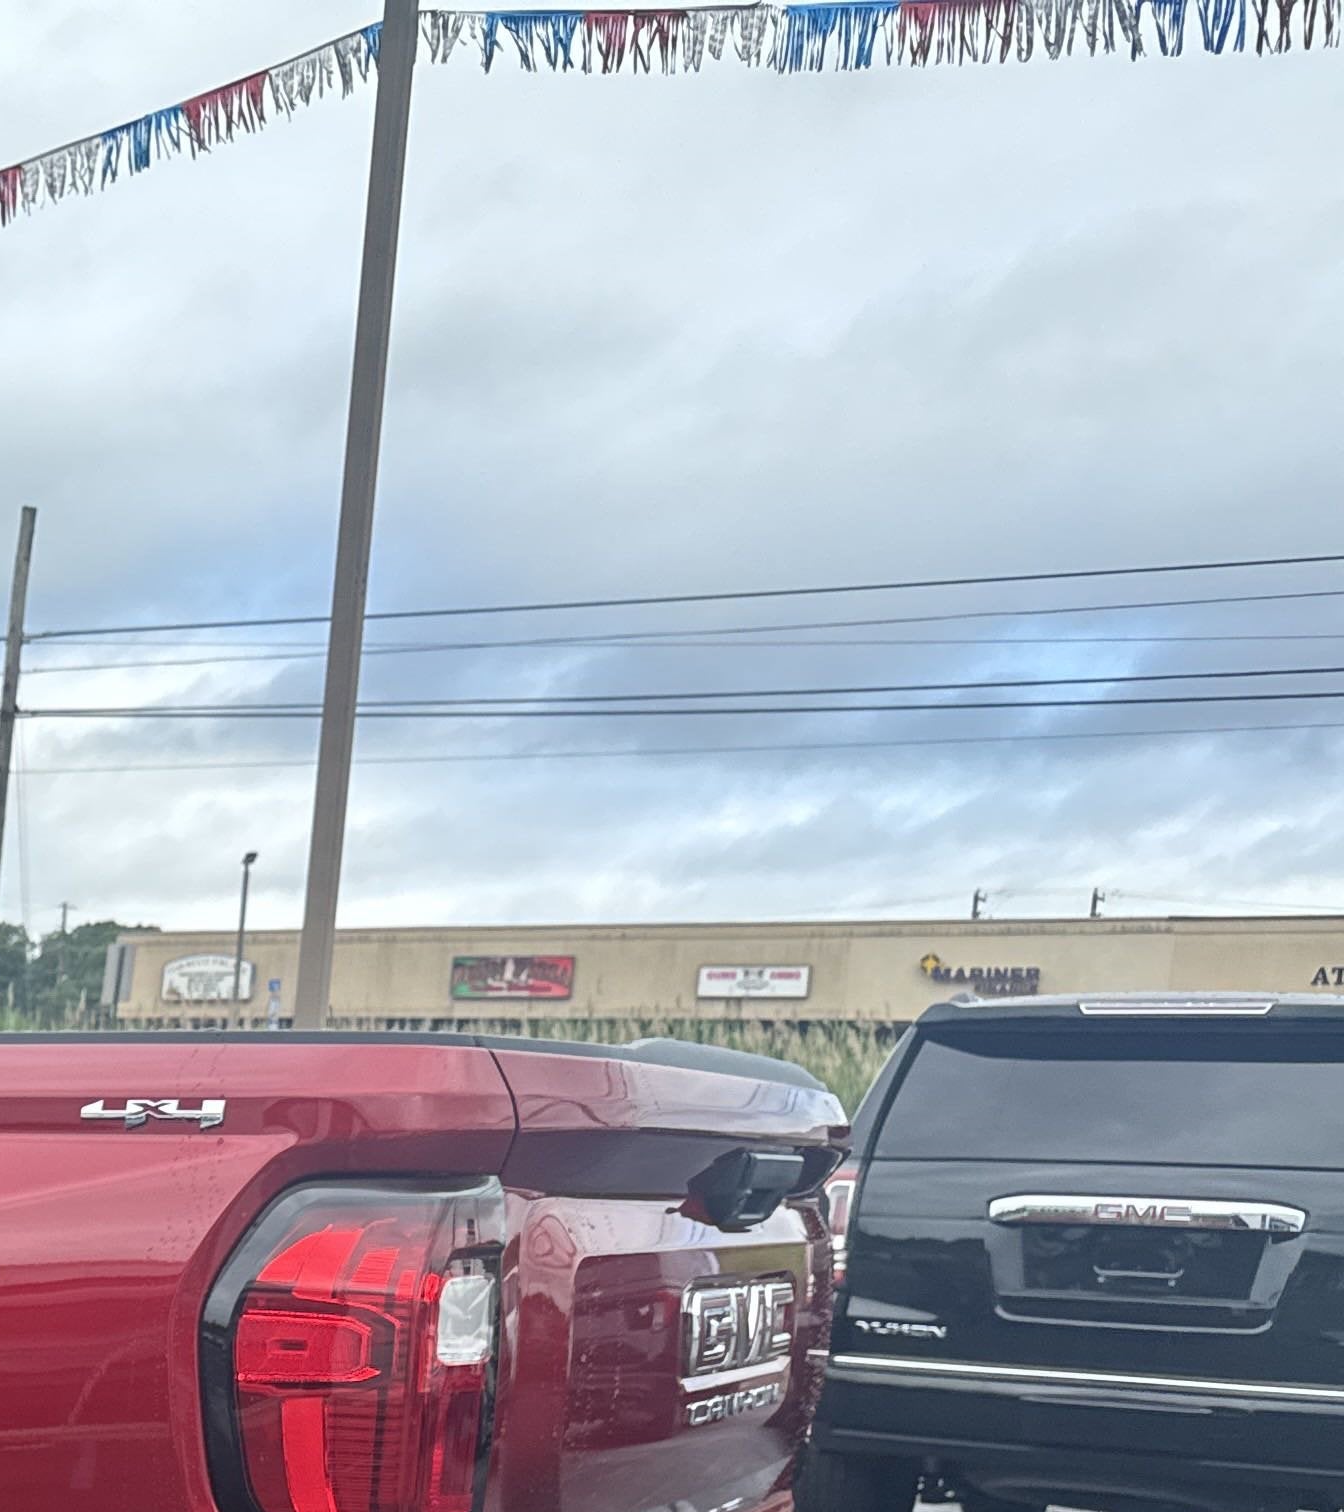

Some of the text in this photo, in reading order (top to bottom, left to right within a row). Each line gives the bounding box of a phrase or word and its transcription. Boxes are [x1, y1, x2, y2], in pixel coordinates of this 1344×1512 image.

[930, 965, 1040, 982] MARINER
[1094, 1204, 1191, 1222] GMC
[684, 1282, 796, 1377] GMC
